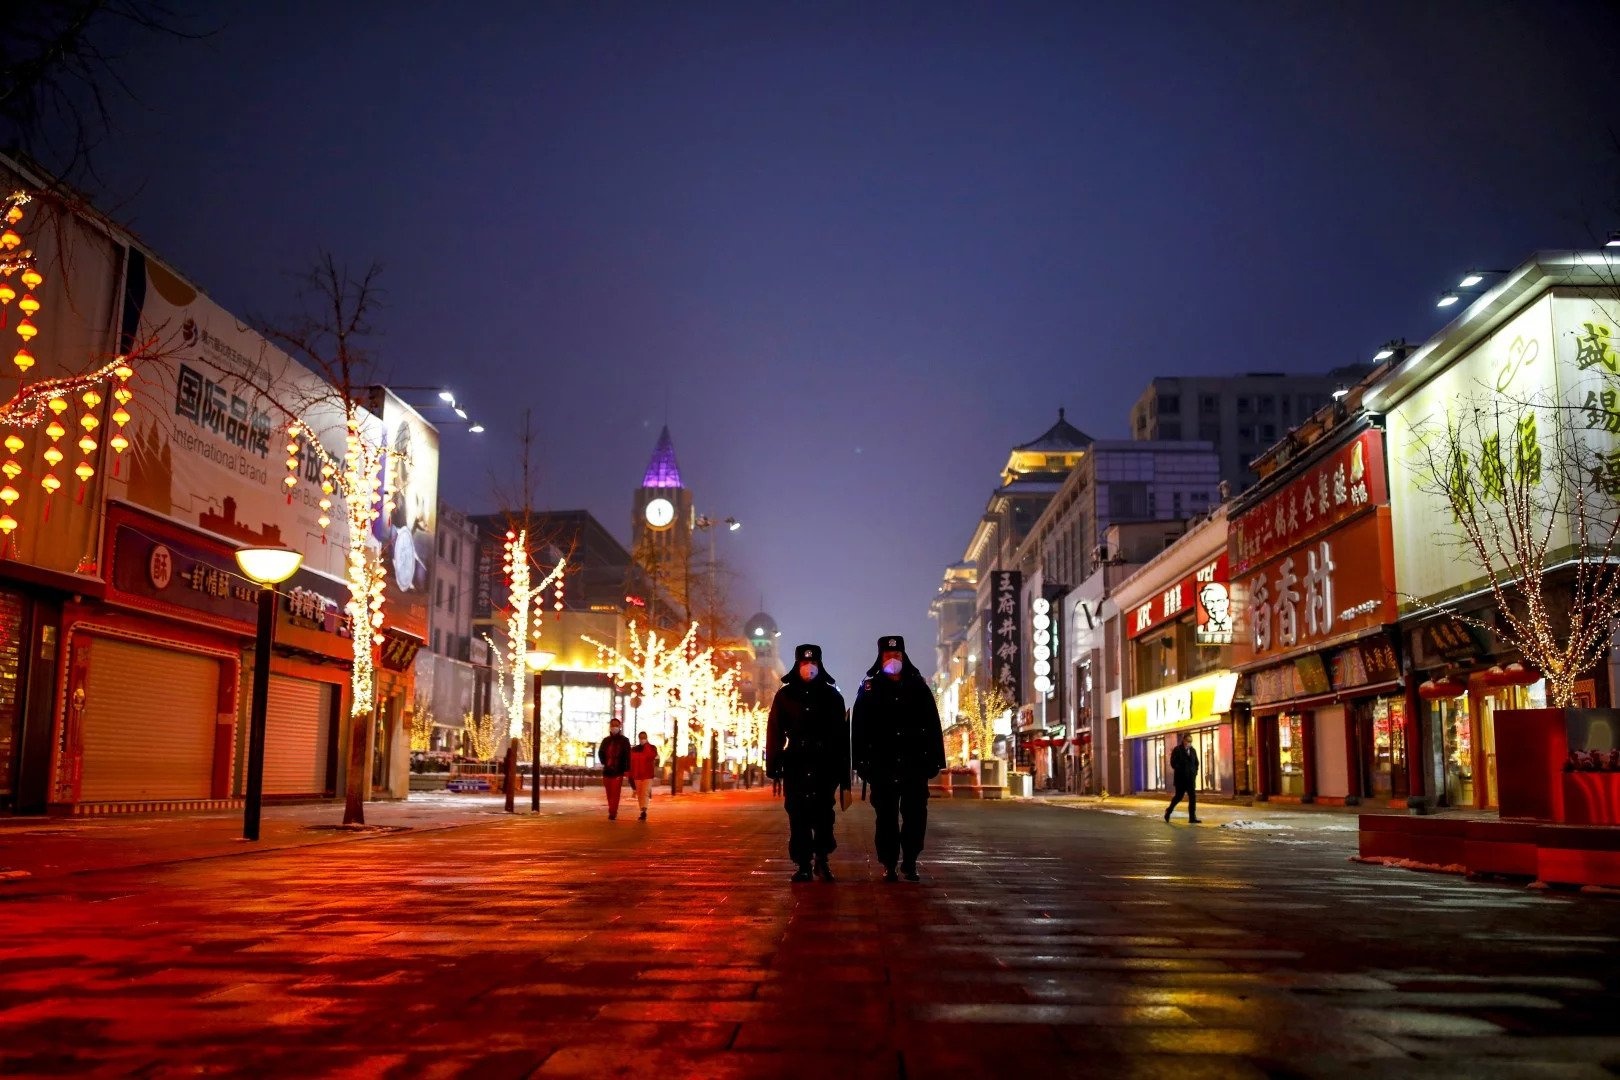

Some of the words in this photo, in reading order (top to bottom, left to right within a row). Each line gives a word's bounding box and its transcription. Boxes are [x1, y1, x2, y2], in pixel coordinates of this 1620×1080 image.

[175, 363, 271, 460] 国际品牌
[173, 427, 240, 473] International
[239, 452, 267, 485] Brand
[153, 552, 168, 582] 酥
[1248, 541, 1336, 656] 稻香村
